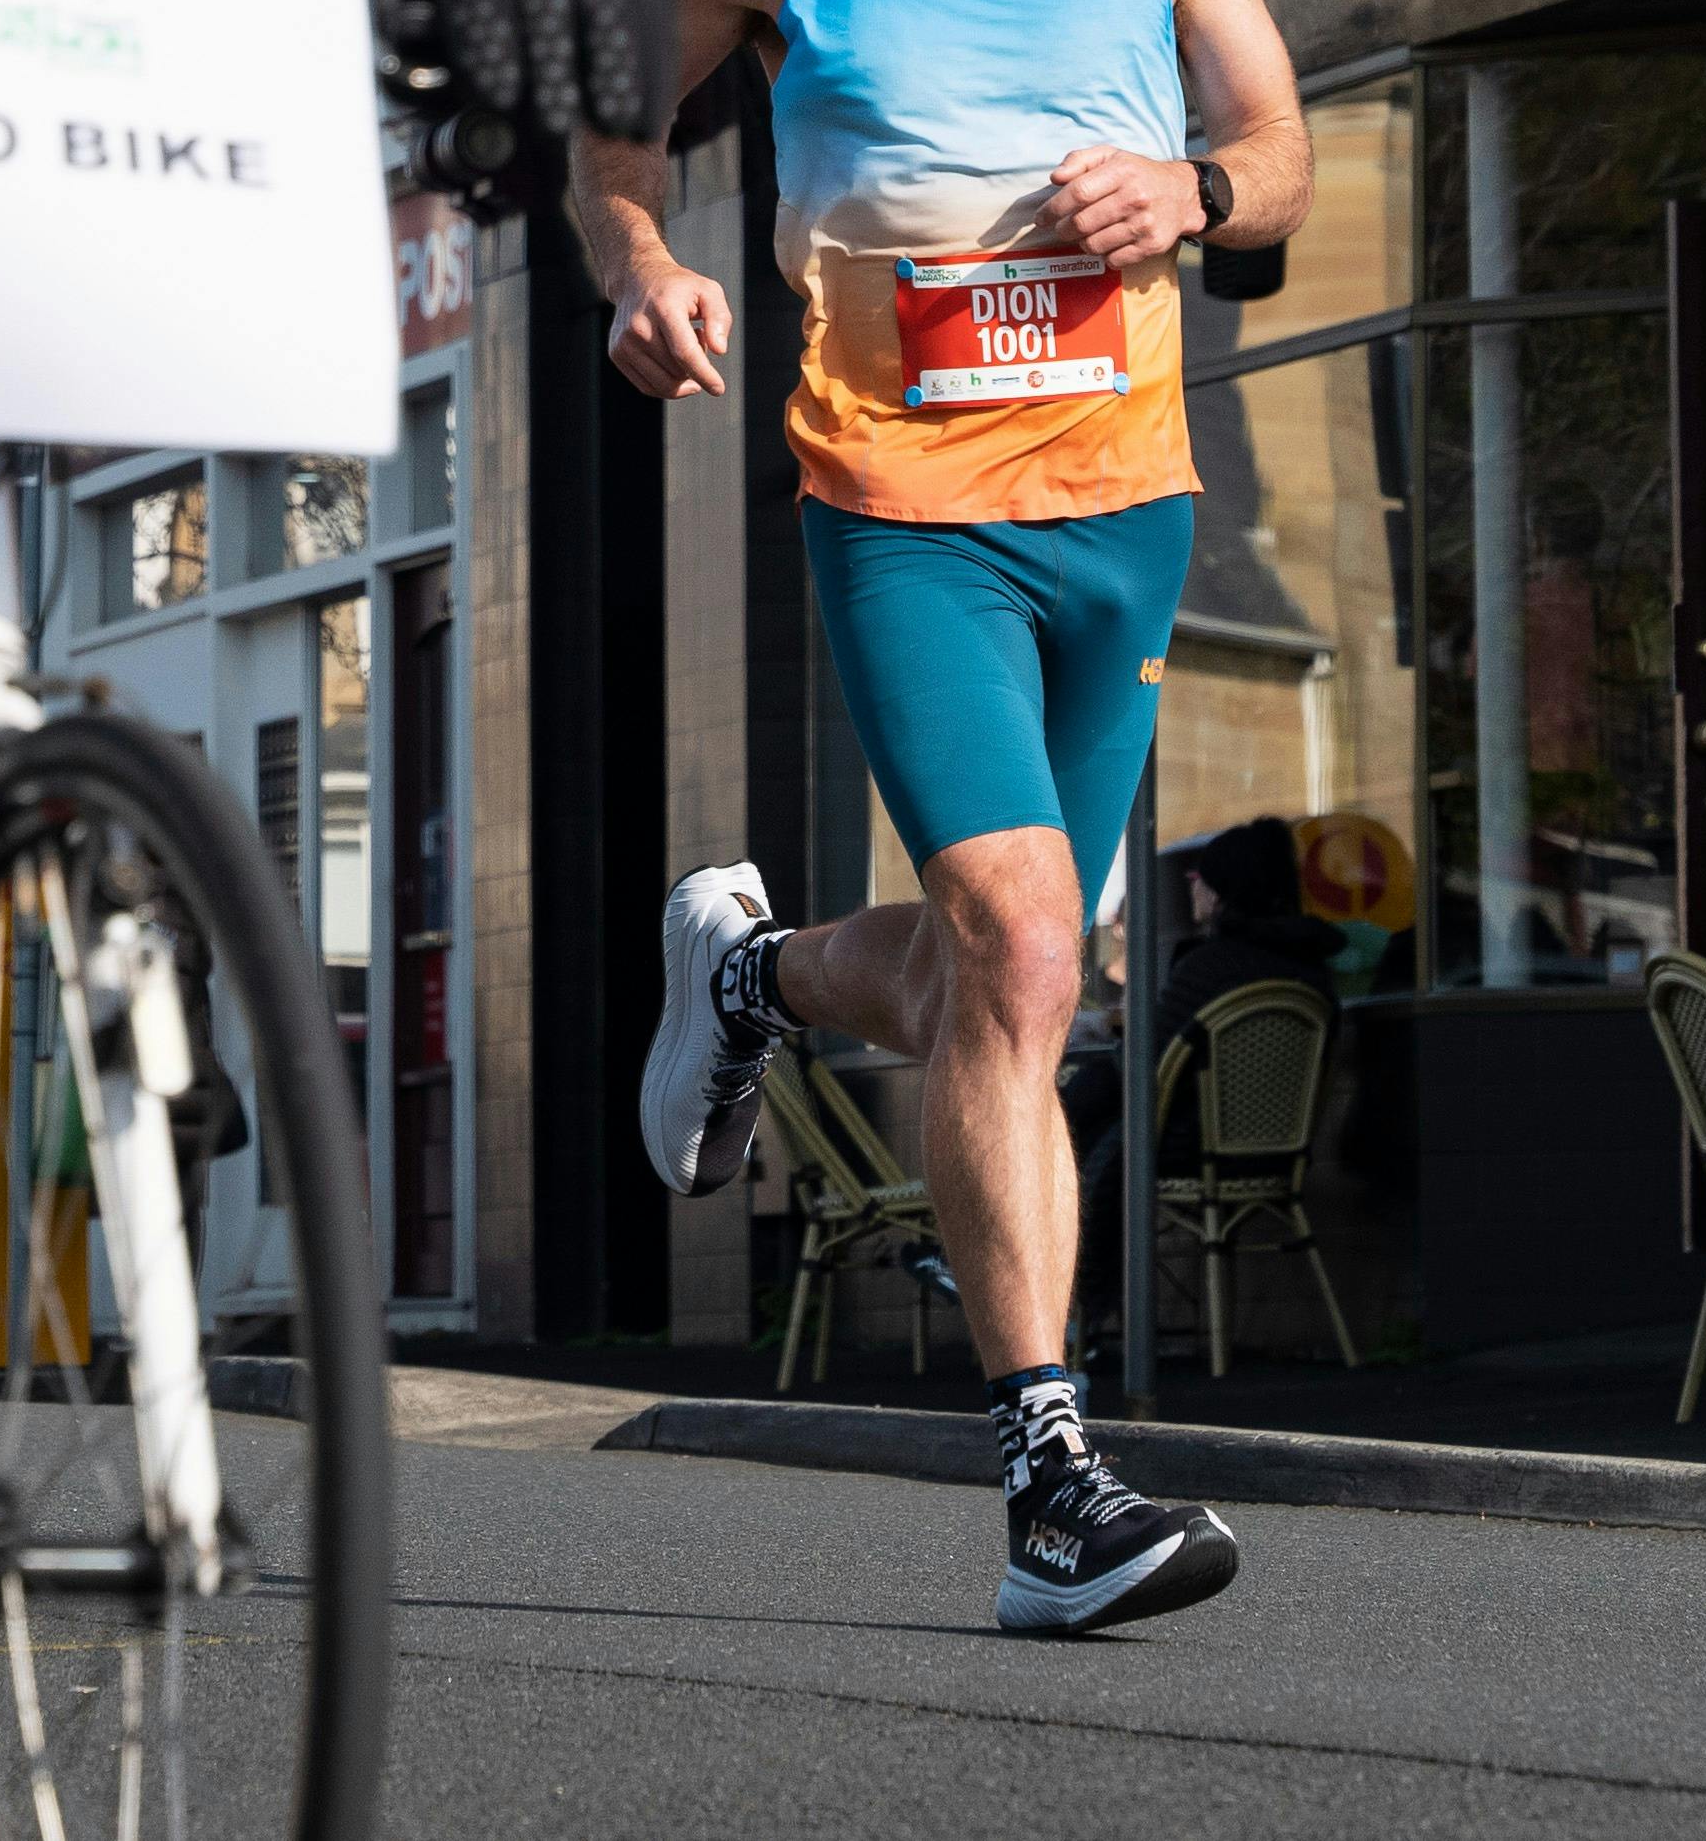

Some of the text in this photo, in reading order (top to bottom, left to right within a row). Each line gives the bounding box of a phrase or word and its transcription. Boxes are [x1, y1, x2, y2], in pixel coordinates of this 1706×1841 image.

[62, 119, 275, 190] BIKE
[1049, 259, 1101, 274] marathon
[971, 282, 1058, 324] DION
[976, 322, 1057, 364] 1001
[1025, 1519, 1083, 1574] HOKA
